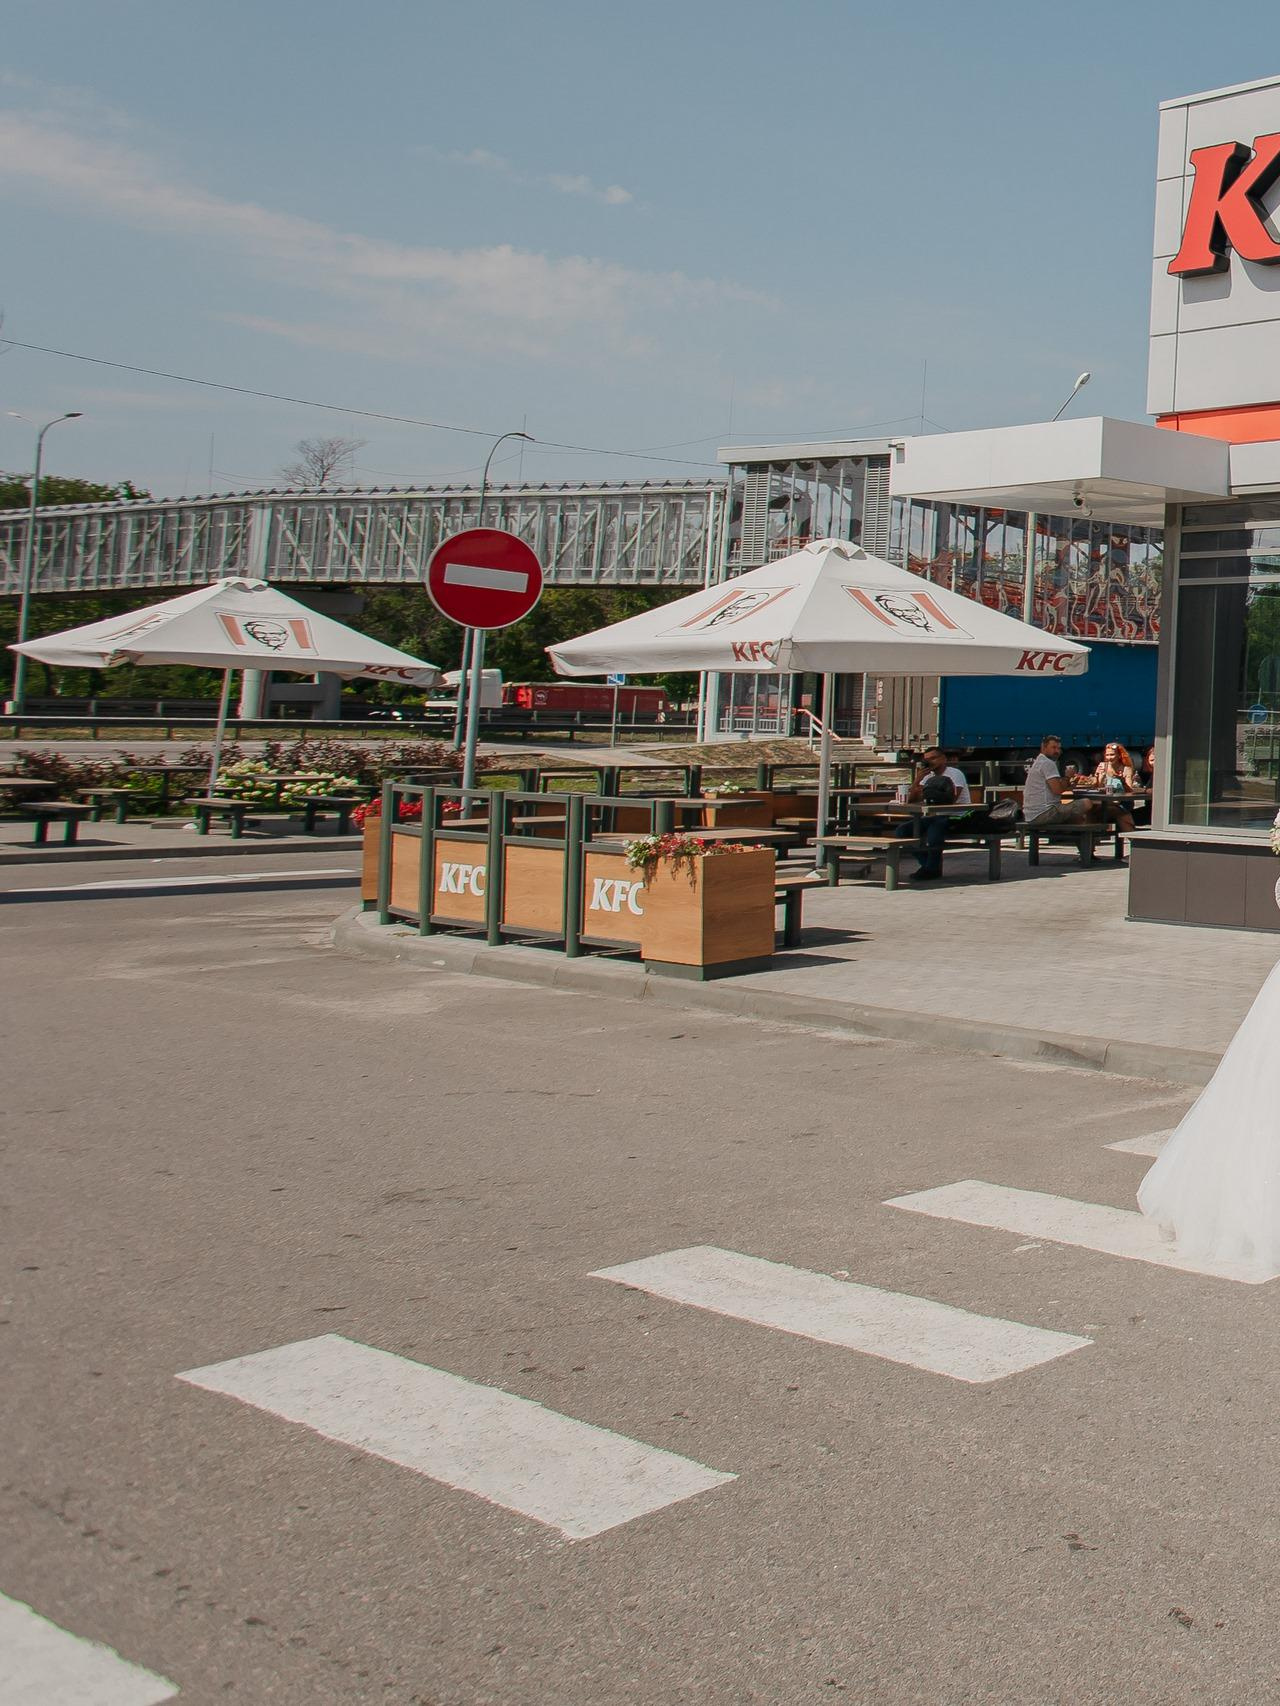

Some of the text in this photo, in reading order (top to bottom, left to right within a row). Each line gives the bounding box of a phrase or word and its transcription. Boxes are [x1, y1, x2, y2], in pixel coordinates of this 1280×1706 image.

[731, 641, 774, 662] KFC
[1015, 650, 1073, 671] KFC
[439, 862, 486, 896] KFC
[590, 878, 644, 916] KFC
